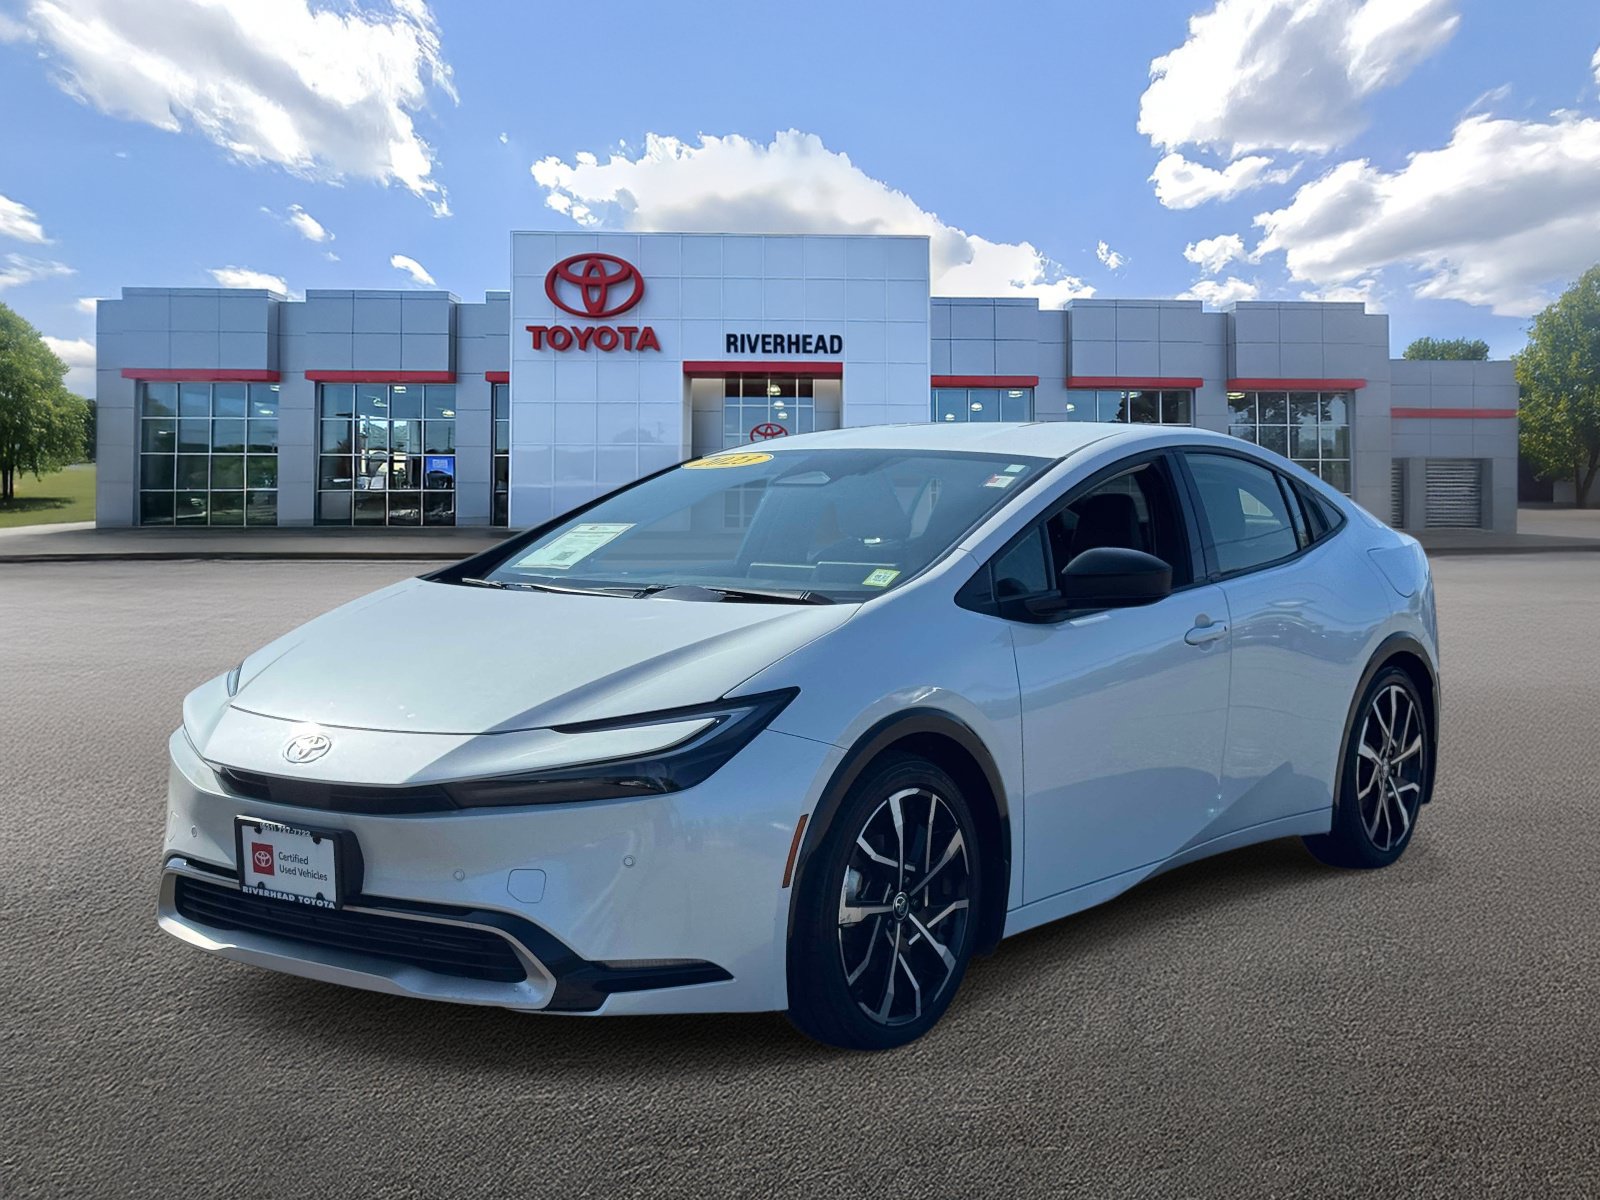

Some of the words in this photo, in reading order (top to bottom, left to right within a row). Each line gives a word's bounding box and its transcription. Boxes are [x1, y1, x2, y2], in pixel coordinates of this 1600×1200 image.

[526, 325, 661, 352] TOYOTA
[726, 333, 843, 354] RIVERHEAD
[278, 851, 309, 865] Certified
[280, 864, 297, 876] Used
[298, 867, 328, 881] Vehicles
[242, 886, 296, 902] RIVERHEAD
[299, 896, 335, 909] TOYOTA
